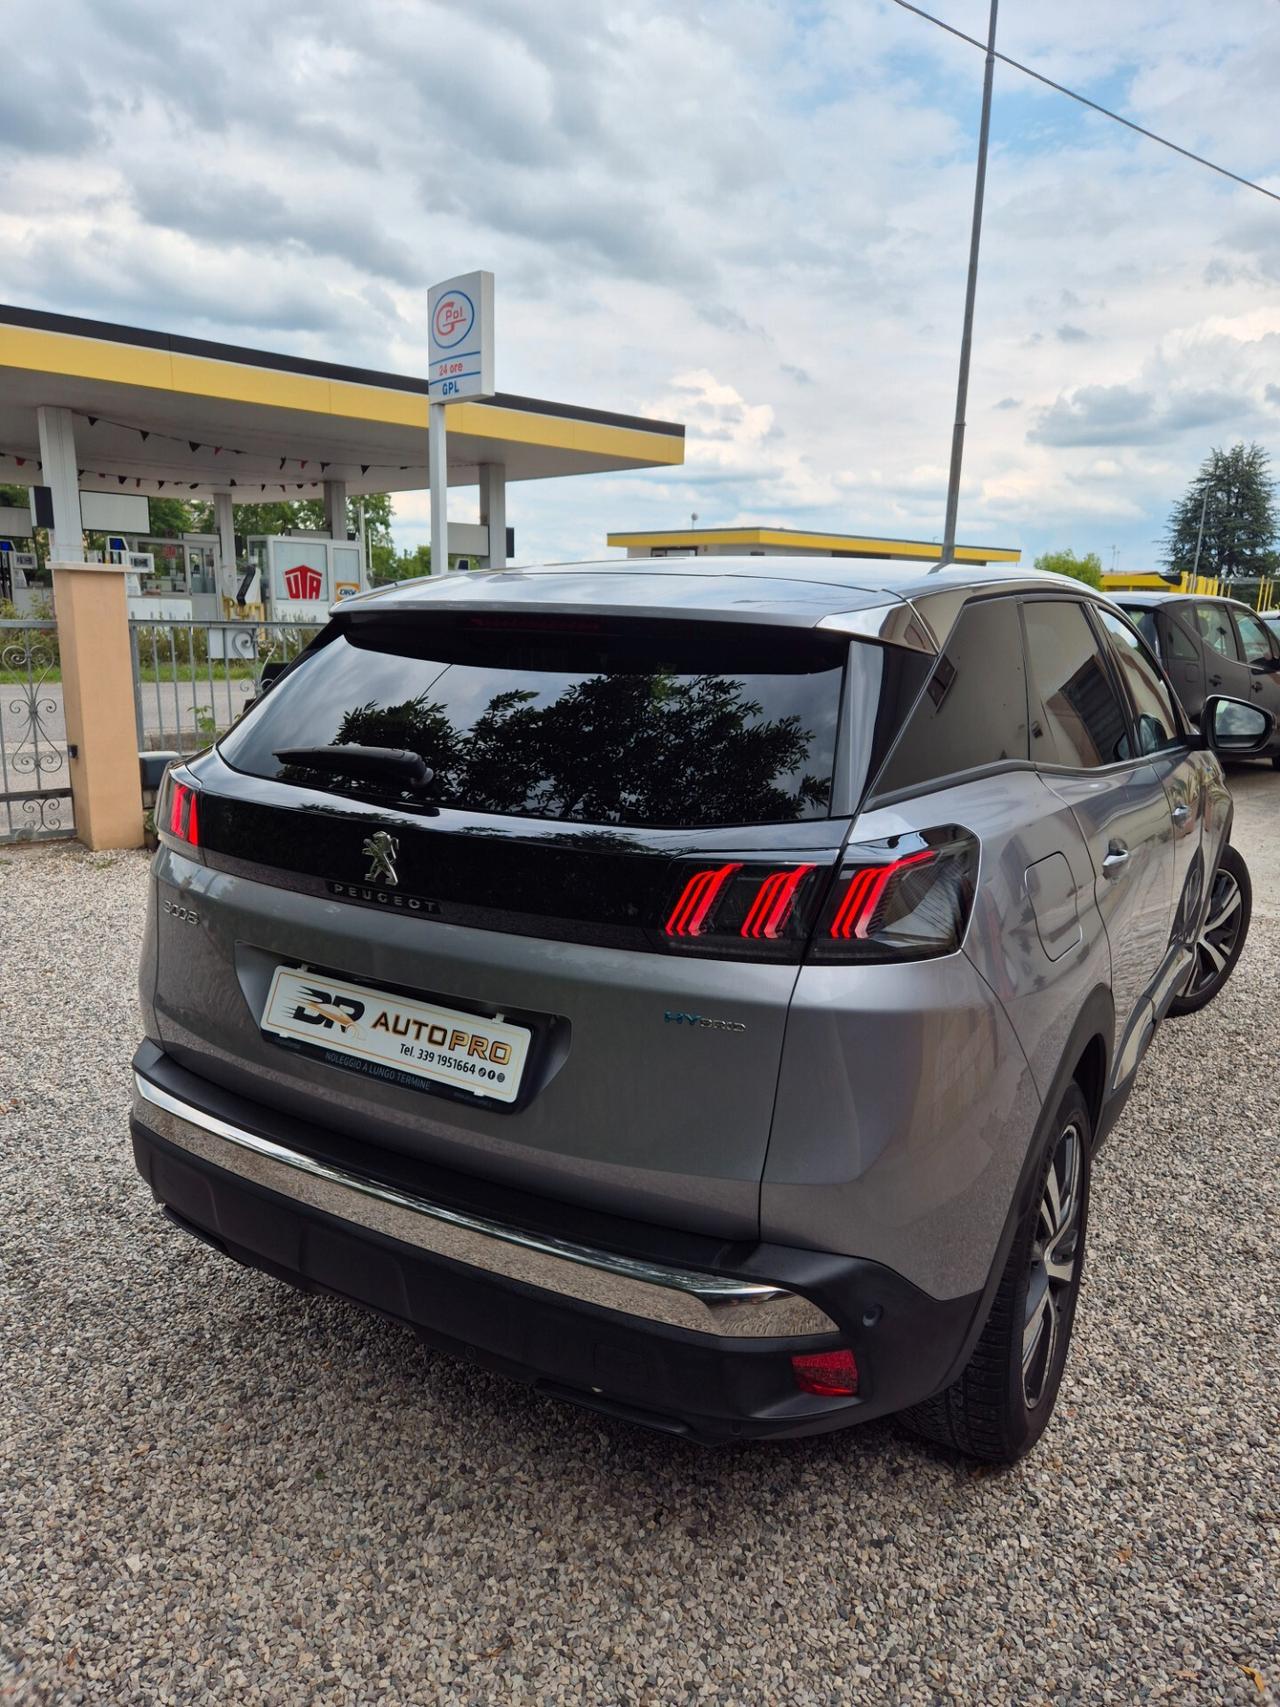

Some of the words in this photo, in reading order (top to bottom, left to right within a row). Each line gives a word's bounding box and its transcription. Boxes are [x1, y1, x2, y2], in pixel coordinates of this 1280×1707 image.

[439, 364, 448, 376] 24
[450, 362, 463, 373] ore
[442, 381, 459, 395] GPL
[285, 565, 322, 599] UTA
[334, 883, 436, 911] PEUGEOT
[163, 900, 199, 925] 3008
[325, 1051, 362, 1069] NOLEGGIO
[362, 1063, 368, 1072] A
[369, 1065, 395, 1080] LUNGO
[397, 1072, 431, 1090] TERMINE
[400, 1043, 415, 1058] Tel.
[417, 1048, 435, 1062] 339
[437, 1054, 476, 1075] 1951664
